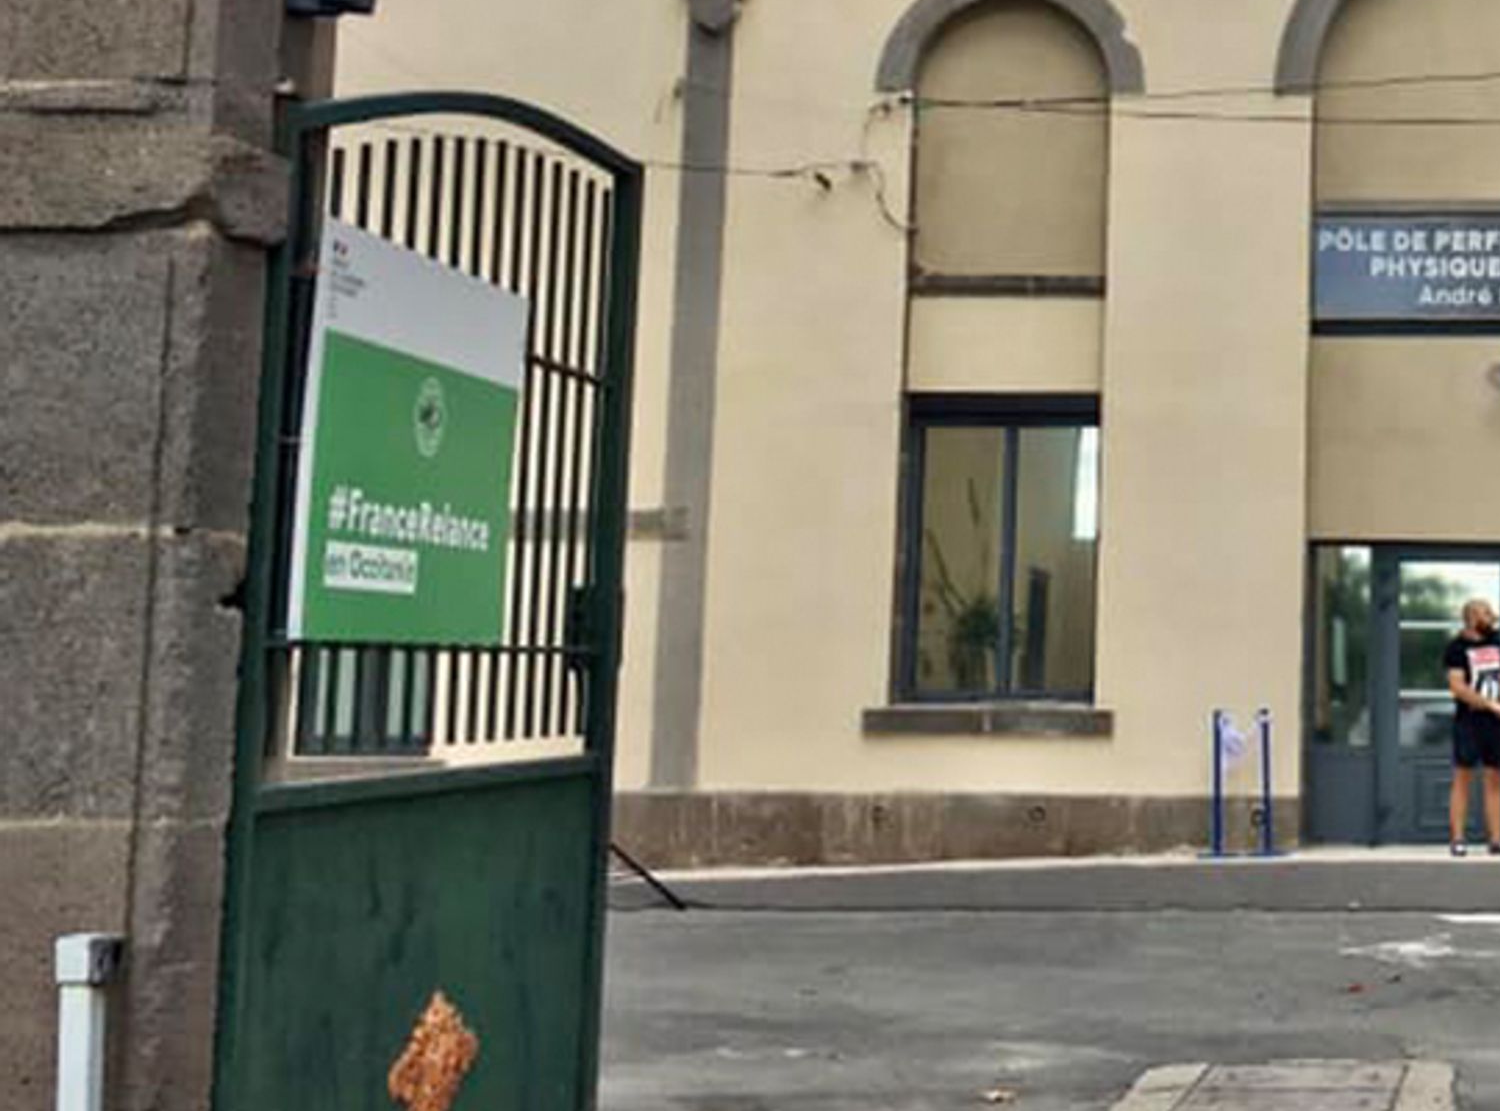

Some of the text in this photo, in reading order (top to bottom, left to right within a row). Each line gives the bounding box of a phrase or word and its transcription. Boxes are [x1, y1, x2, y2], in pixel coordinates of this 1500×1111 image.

[1319, 223, 1386, 251] PÔLE
[1394, 230, 1427, 251] DE
[1370, 256, 1500, 277] PHYSIQUE
[1418, 285, 1492, 305] André
